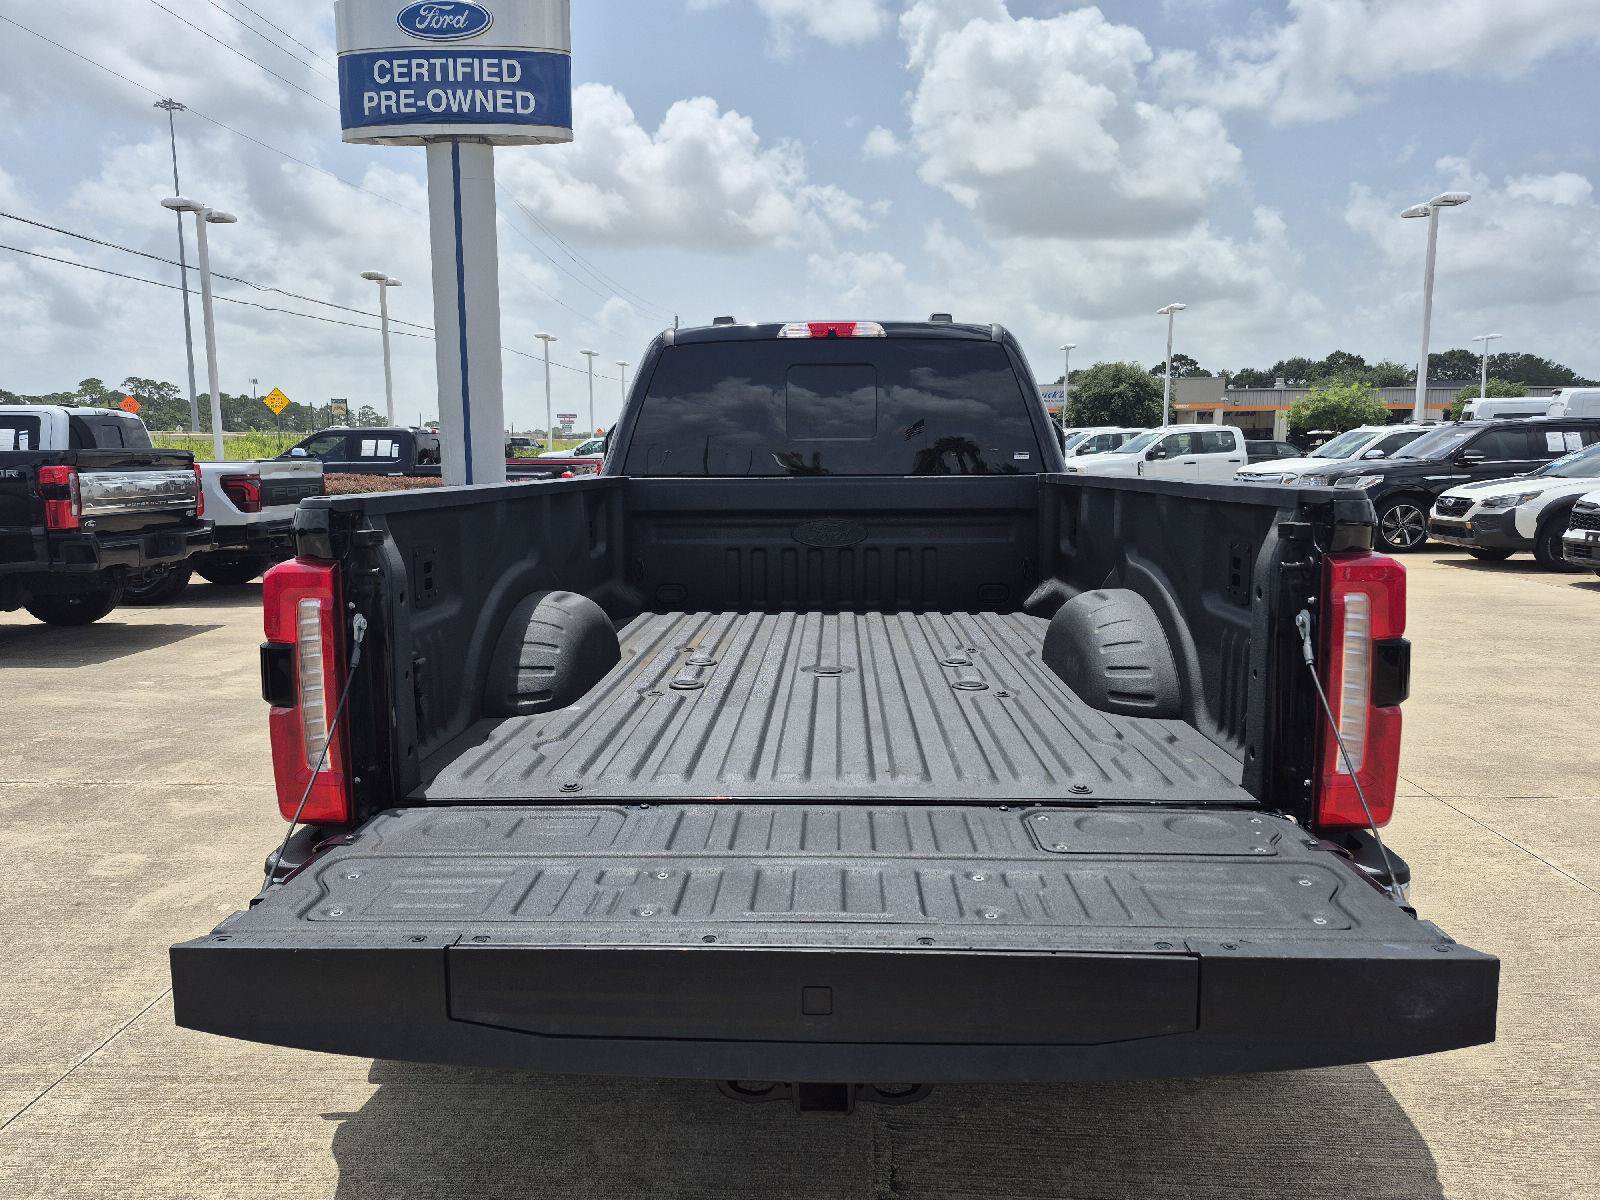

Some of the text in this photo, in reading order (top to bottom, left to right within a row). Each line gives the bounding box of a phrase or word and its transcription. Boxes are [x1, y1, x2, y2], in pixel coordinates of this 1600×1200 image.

[415, 4, 469, 29] Ford
[373, 58, 522, 84] CERTIFIED
[363, 89, 536, 115] PRE-OWNED
[272, 485, 320, 497] FORD
